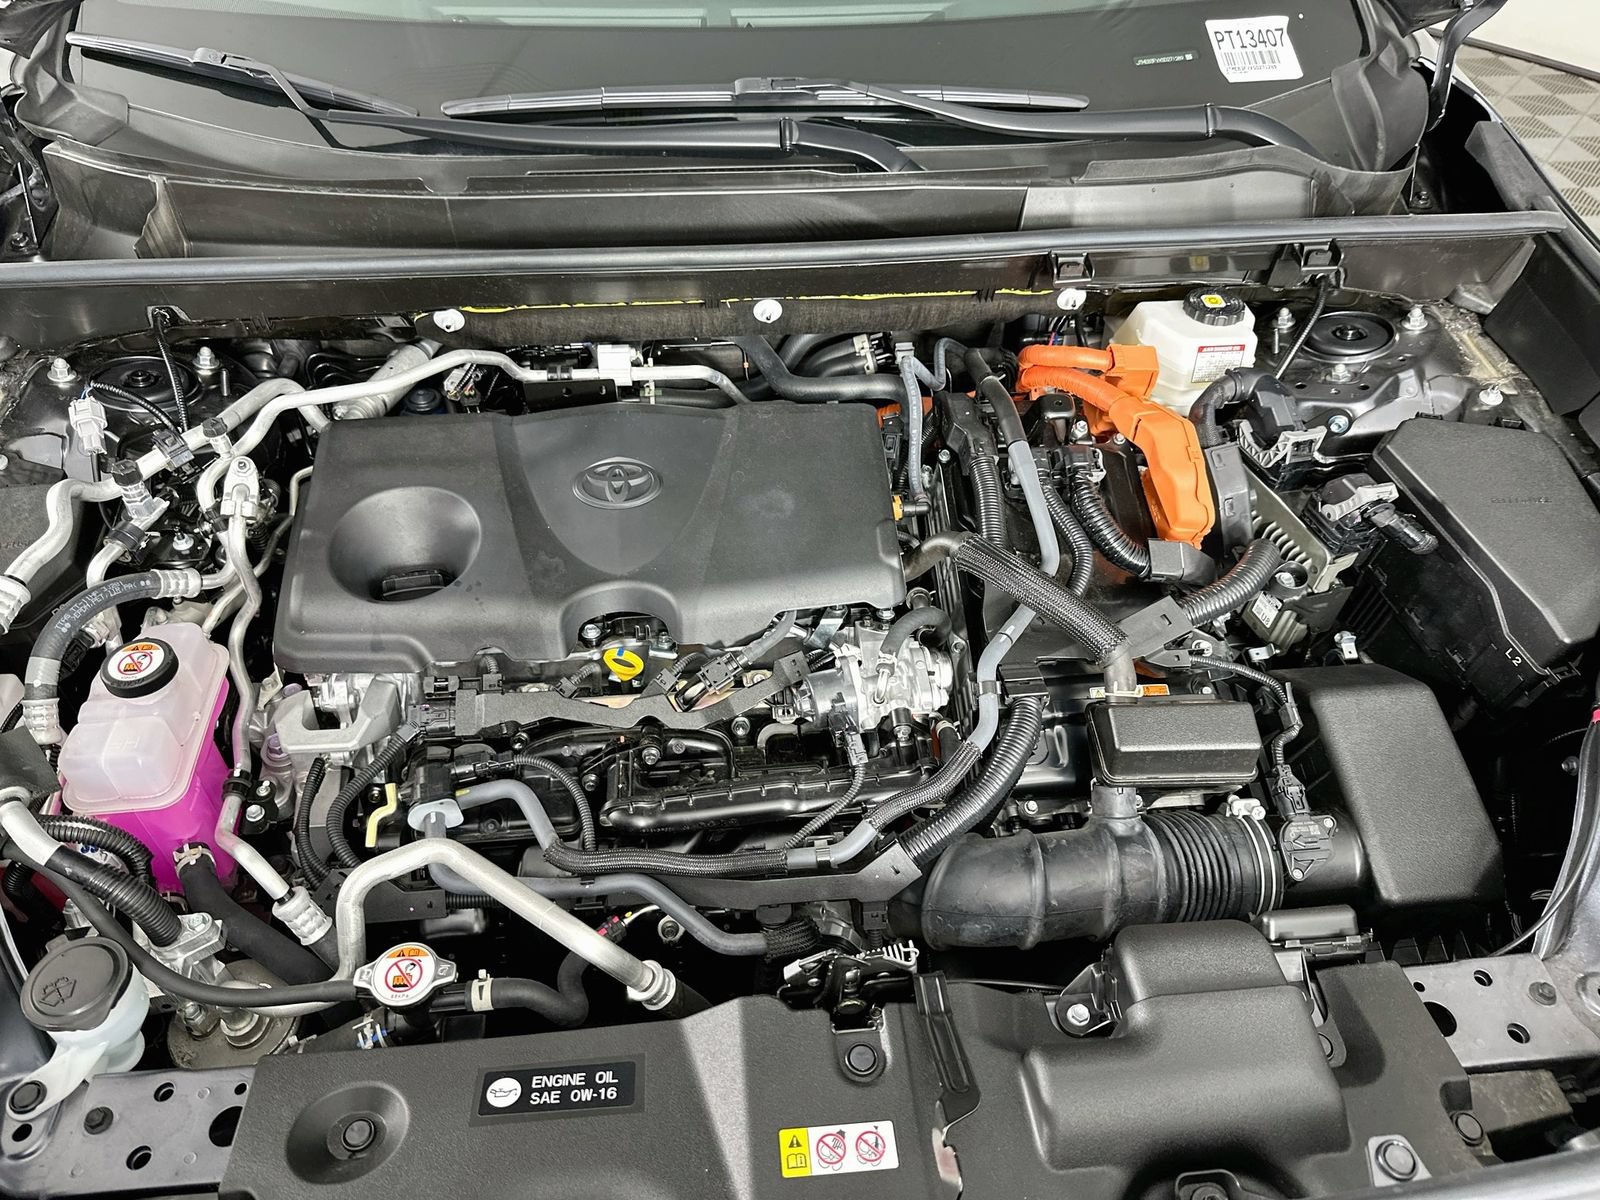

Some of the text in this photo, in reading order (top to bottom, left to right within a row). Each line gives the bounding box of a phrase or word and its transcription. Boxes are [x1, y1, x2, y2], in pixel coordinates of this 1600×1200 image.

[1214, 28, 1284, 50] PT13407
[1505, 648, 1522, 667] L2
[531, 1071, 619, 1089] ENGINE OIL
[530, 1087, 618, 1105] SAE 0W-16
